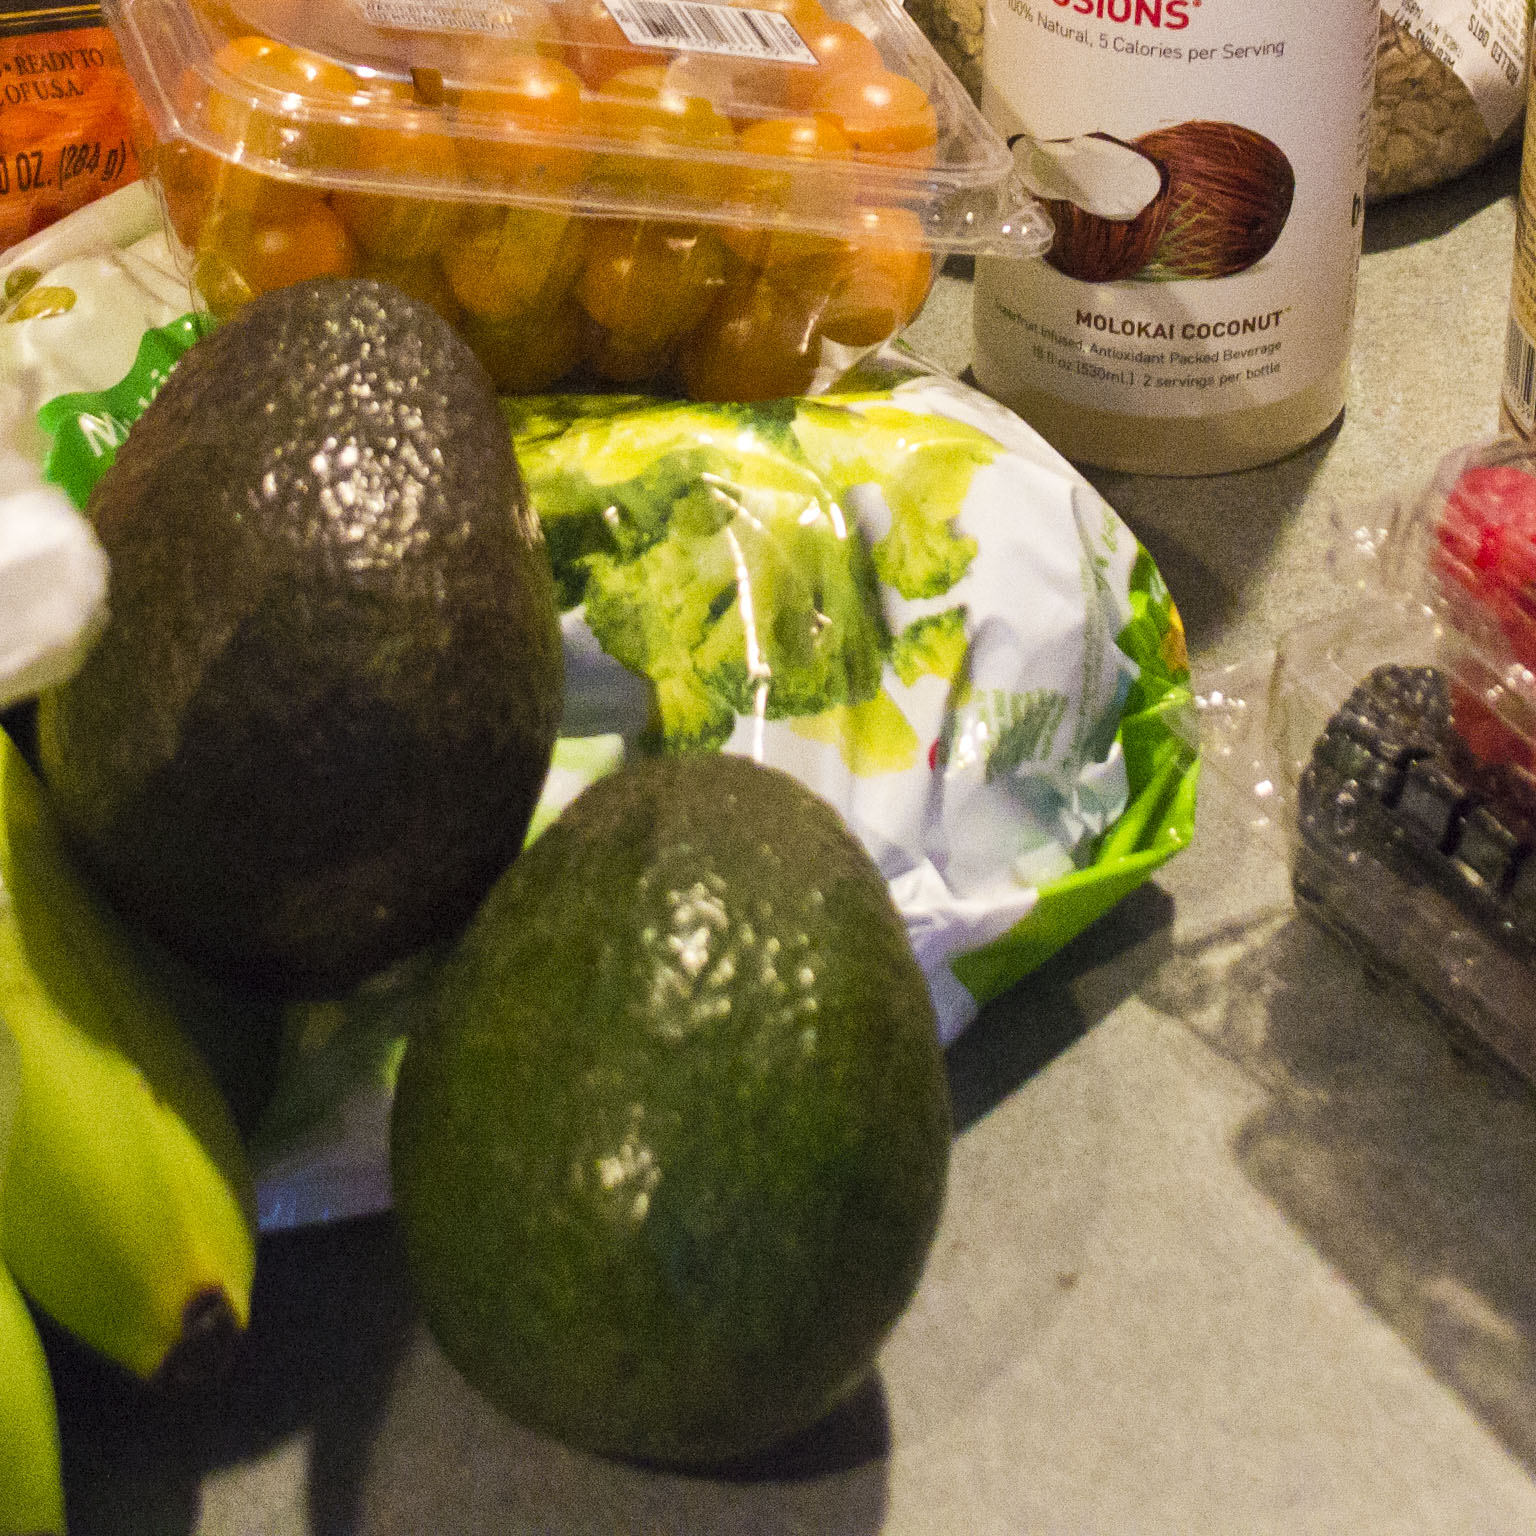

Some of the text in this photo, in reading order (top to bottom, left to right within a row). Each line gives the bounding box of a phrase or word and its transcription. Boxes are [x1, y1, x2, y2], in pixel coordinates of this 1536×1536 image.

[1037, 10, 1094, 47] Natural,
[1099, 32, 1110, 49] 5
[1112, 36, 1183, 61] Calories
[1187, 44, 1219, 64] per
[1222, 39, 1286, 61] Serving
[14, 47, 106, 76] READY TO
[6, 81, 33, 105] OF
[35, 76, 85, 100] U.S.A.
[15, 149, 54, 193] OZ.
[1075, 308, 1175, 341] MOLOKAI
[1180, 309, 1284, 341] COCONUT
[1090, 343, 1165, 366] Antioxidant
[1170, 349, 1220, 365] Packed
[1223, 340, 1282, 362] Beverage
[1143, 375, 1152, 387] 2
[1156, 373, 1215, 389] servings
[1219, 373, 1241, 387] per
[1246, 362, 1281, 380] bottle
